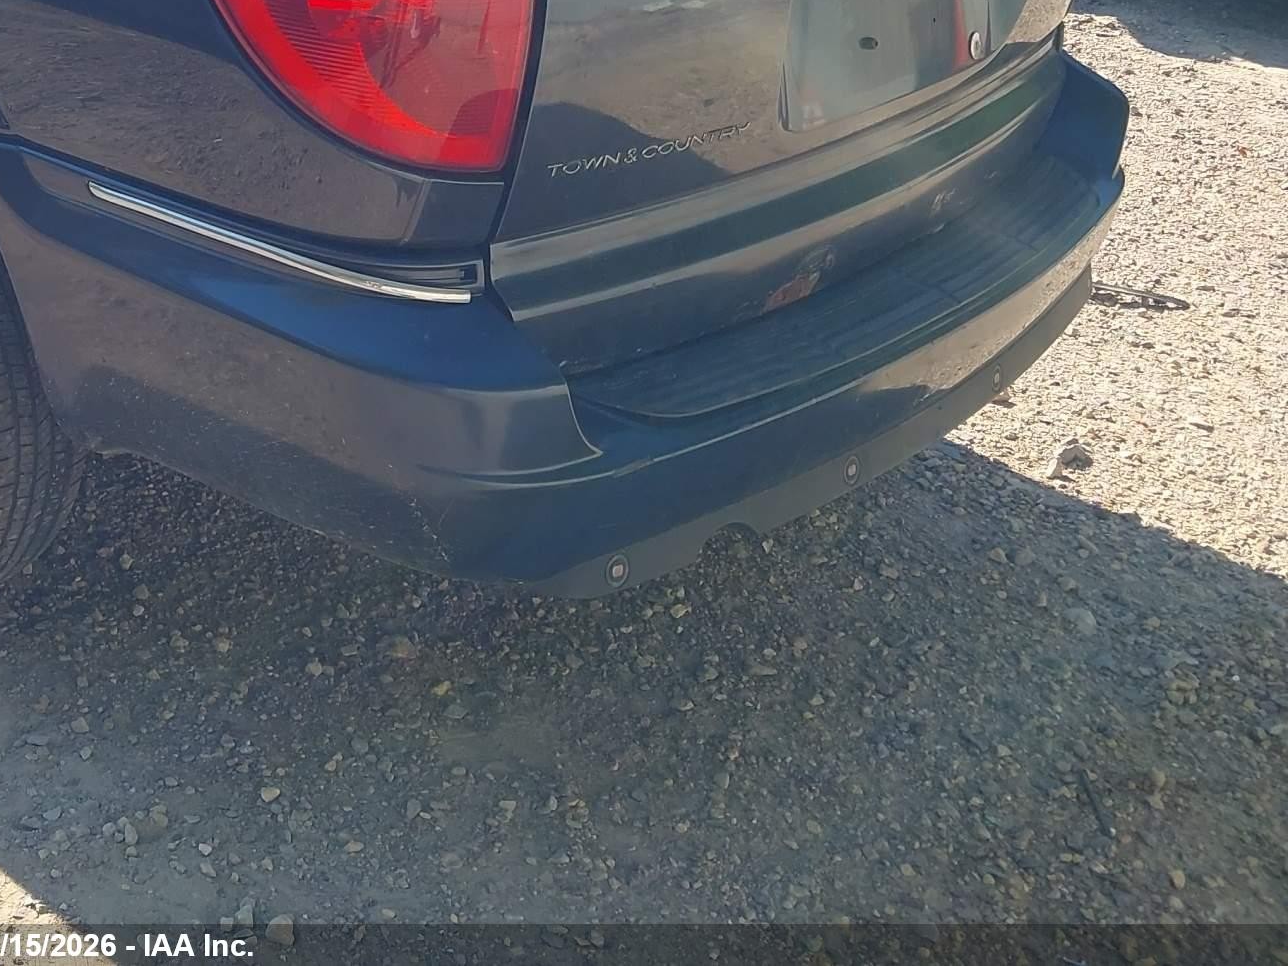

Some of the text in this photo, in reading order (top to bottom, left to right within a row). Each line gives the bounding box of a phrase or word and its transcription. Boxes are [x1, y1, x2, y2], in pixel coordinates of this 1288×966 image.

[547, 121, 752, 178] TOWN & COUNTRY
